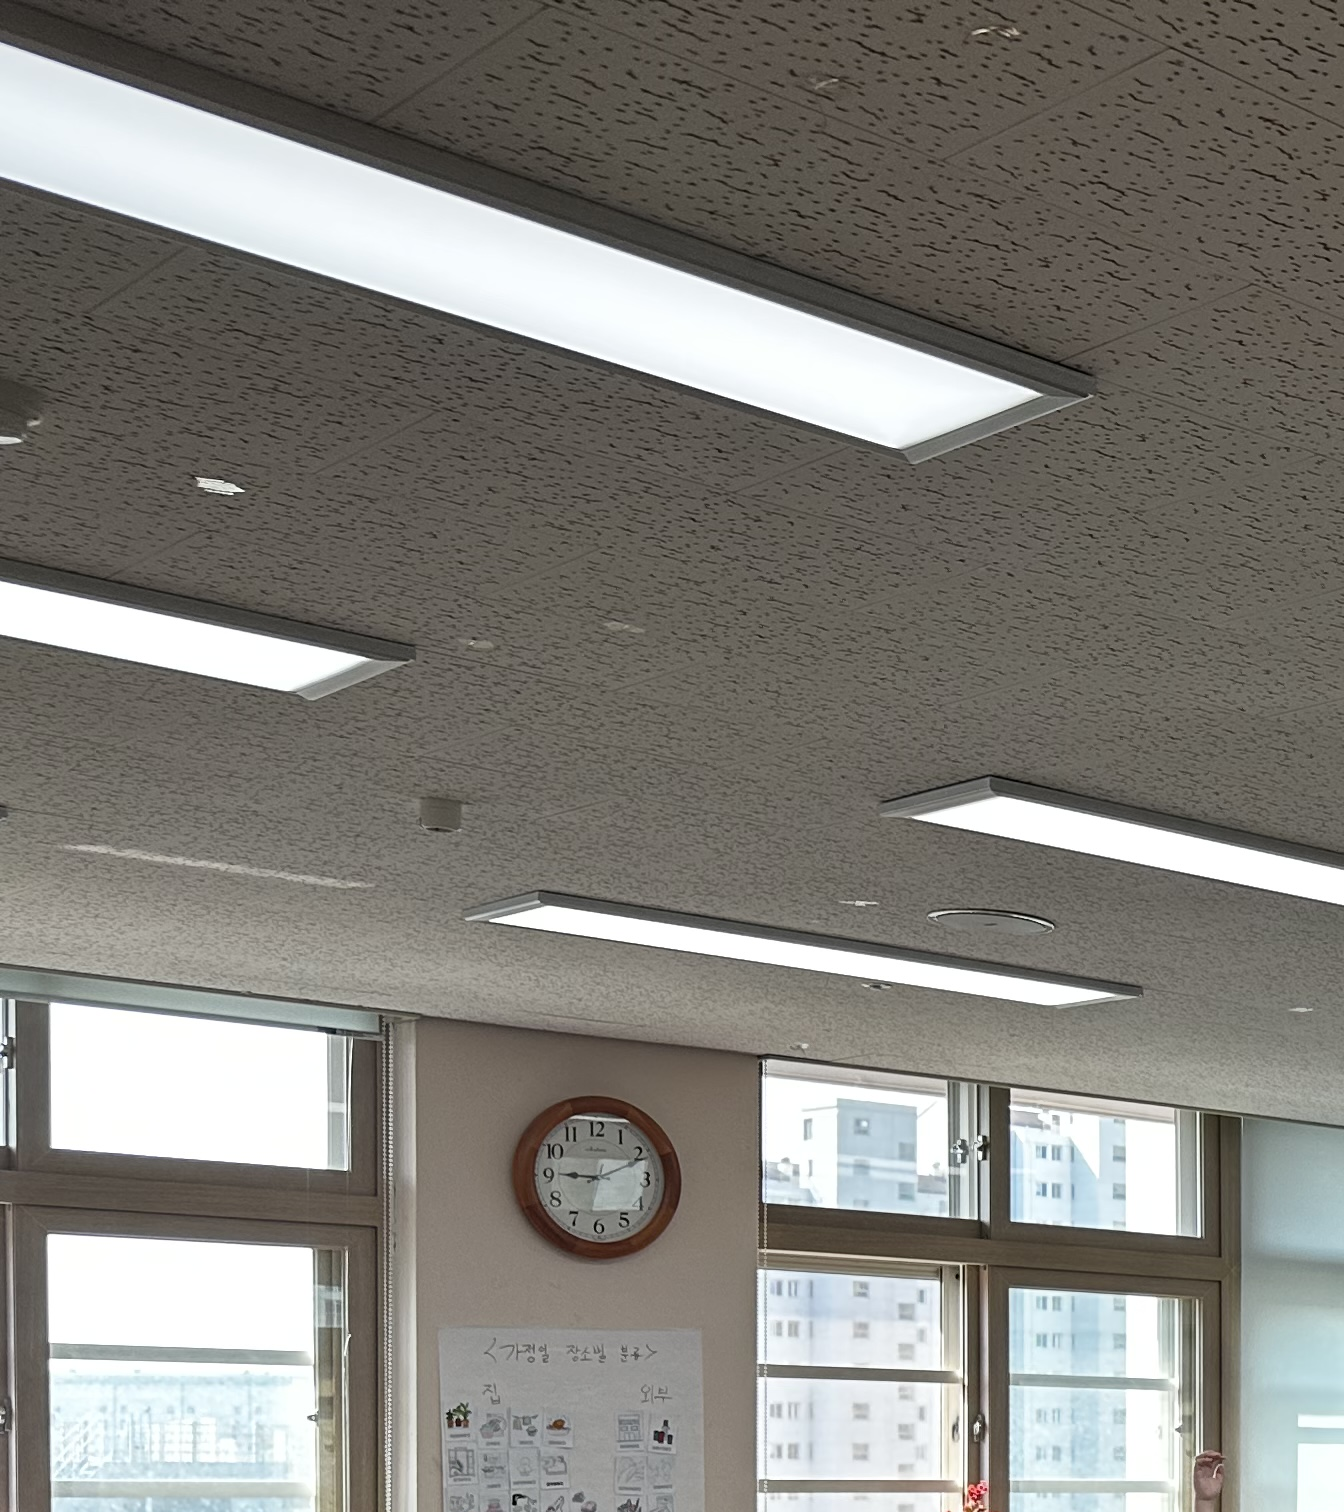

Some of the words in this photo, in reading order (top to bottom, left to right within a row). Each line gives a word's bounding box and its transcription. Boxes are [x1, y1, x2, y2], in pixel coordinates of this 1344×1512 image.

[565, 1126, 577, 1142] 11
[589, 1121, 605, 1137] 12
[618, 1129, 623, 1144] 1
[546, 1143, 564, 1159] 10
[634, 1146, 644, 1161] 2
[543, 1167, 554, 1183] 9
[639, 1171, 650, 1187] 3
[550, 1190, 562, 1207] 8
[632, 1196, 643, 1211] 4
[568, 1210, 578, 1226] 7
[593, 1218, 604, 1234] 6
[618, 1212, 630, 1228] 5
[566, 1344, 606, 1362] 장소별
[482, 1383, 501, 1405] 집
[640, 1384, 673, 1403] 외부
